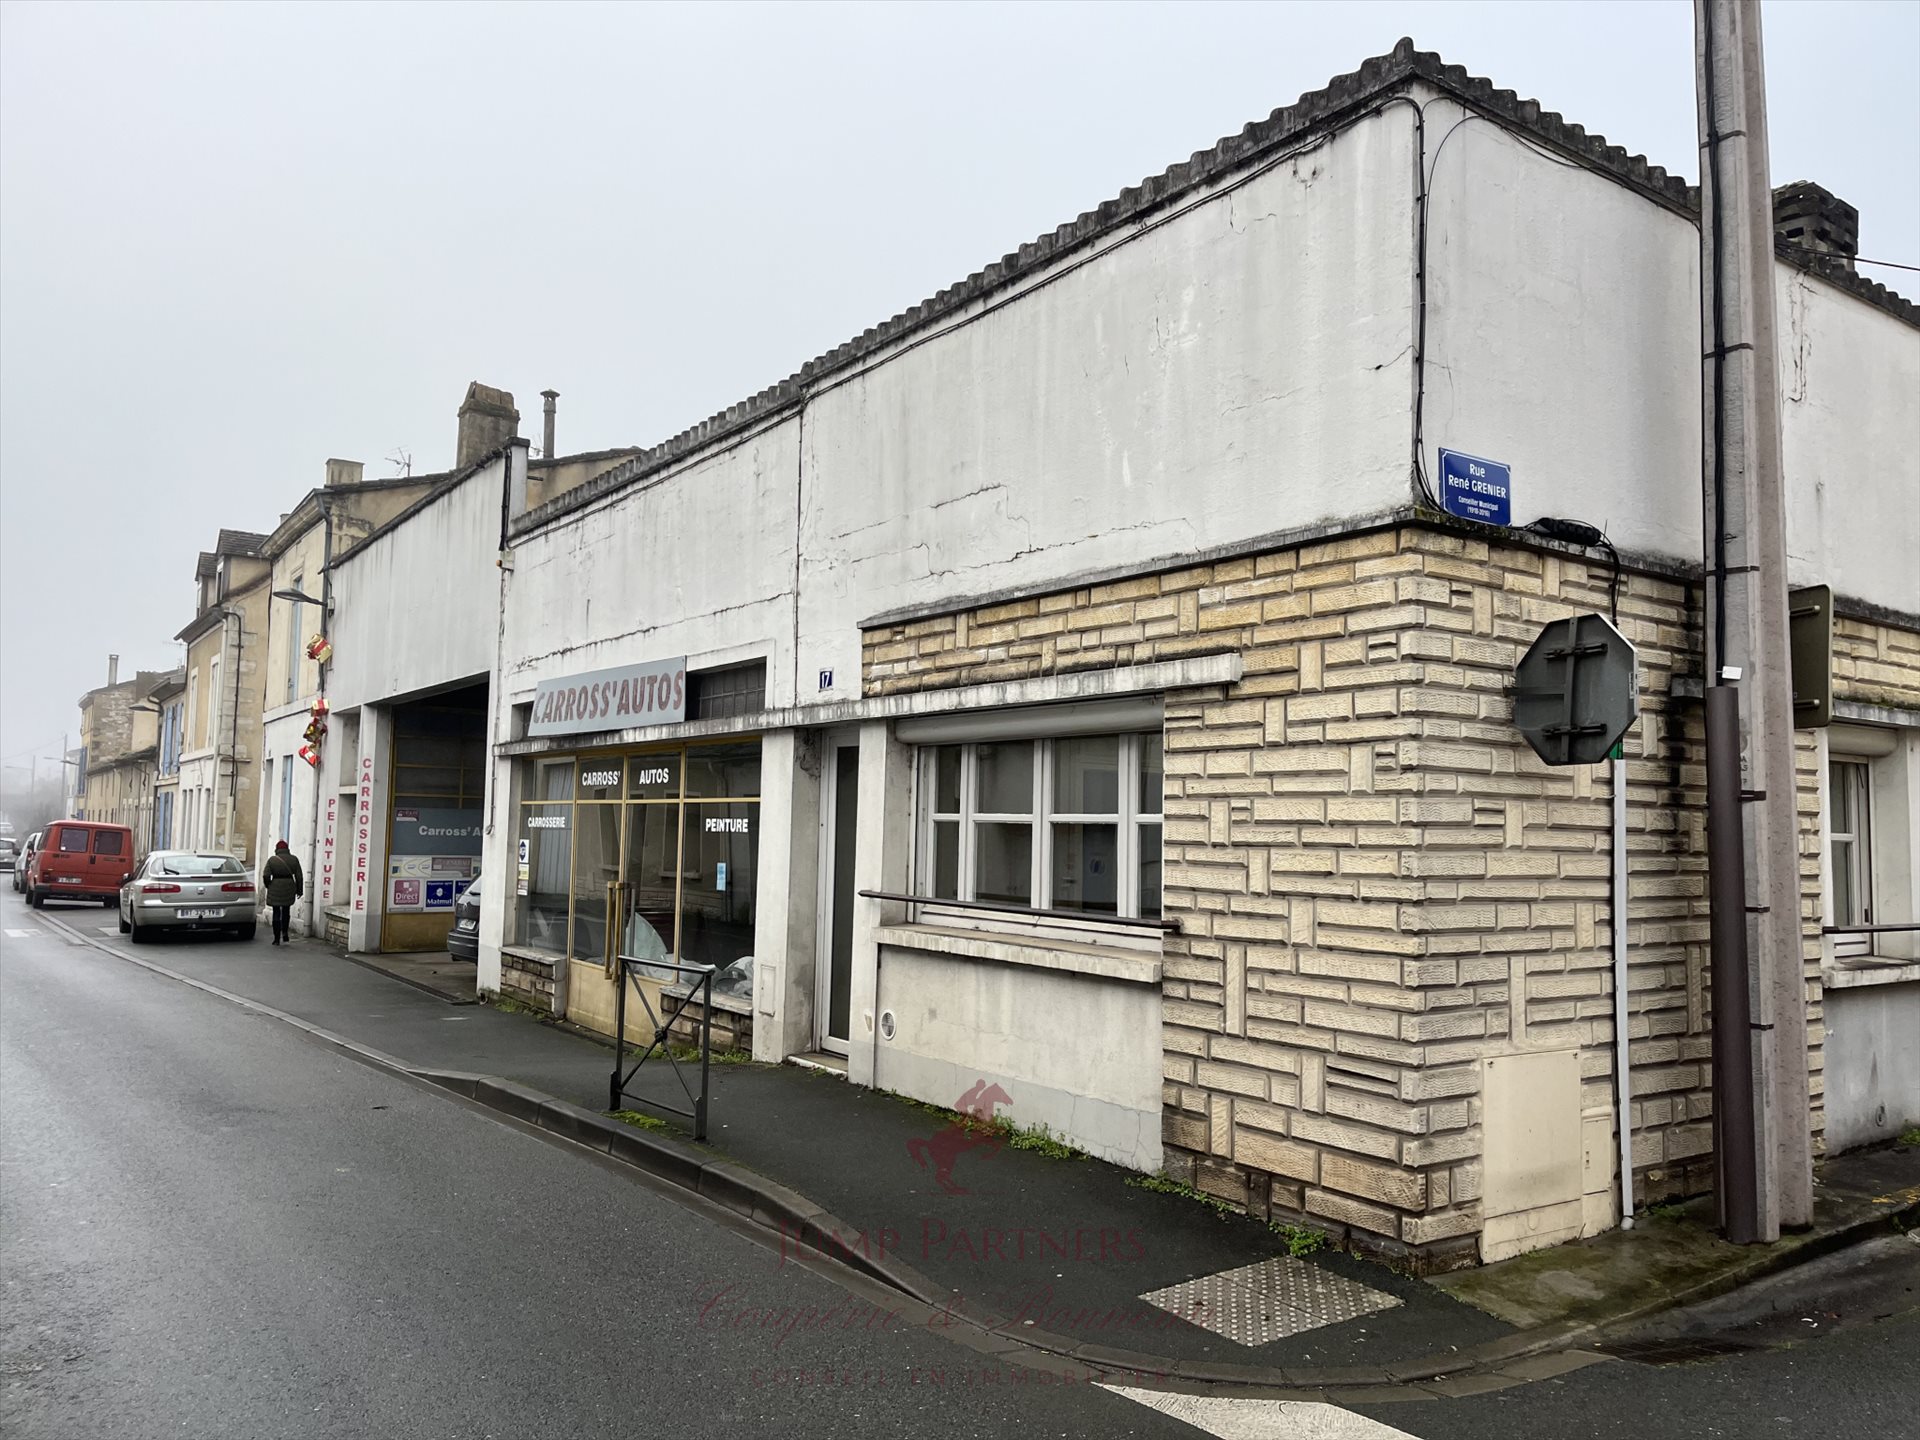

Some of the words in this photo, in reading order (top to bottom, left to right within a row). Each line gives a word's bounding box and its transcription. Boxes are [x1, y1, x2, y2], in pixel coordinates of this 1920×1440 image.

[1469, 464, 1486, 477] Rue
[1448, 474, 1470, 490] René
[1472, 480, 1506, 498] GRENIER
[1458, 495, 1478, 506] Conseiller
[1478, 500, 1499, 511] Municipal
[821, 671, 831, 688] 17
[533, 670, 684, 723] CARROSS'AUTOS
[582, 769, 621, 786] CARROSS'
[639, 768, 670, 785] AUTOS
[418, 825, 471, 837] Carross'
[527, 816, 566, 829] CARROSSERIE
[705, 817, 749, 834] PEINTURE
[355, 757, 372, 911] CARROSSERIE
[322, 797, 336, 900] PEINTURE
[395, 892, 418, 900] Direct
